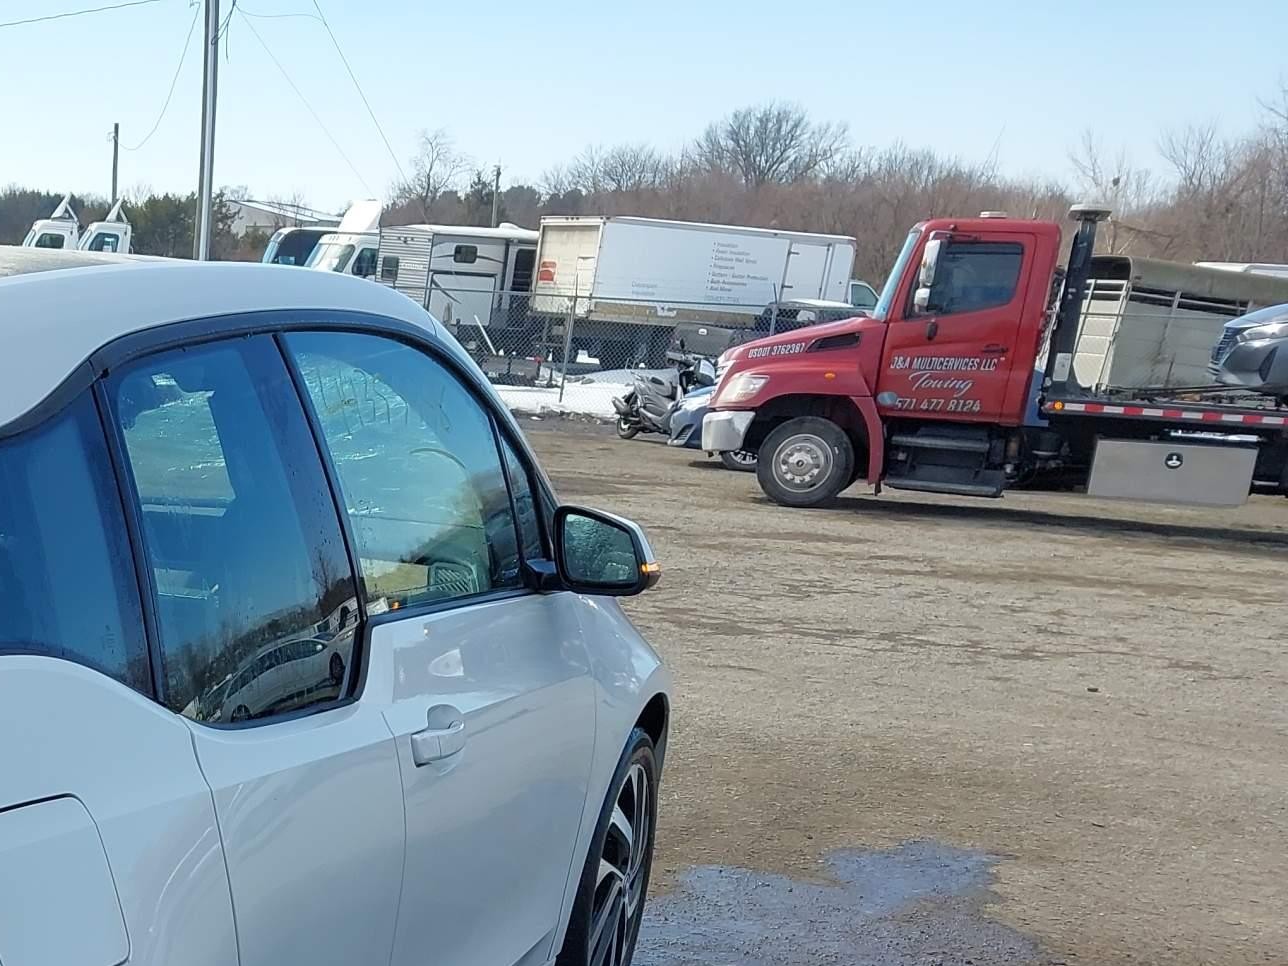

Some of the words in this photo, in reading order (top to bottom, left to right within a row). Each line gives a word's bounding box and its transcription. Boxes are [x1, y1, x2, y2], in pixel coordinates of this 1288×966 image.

[890, 356, 910, 369] J&A
[980, 358, 998, 371] LLC
[908, 370, 974, 397] Towing
[895, 398, 917, 409] 571
[920, 398, 944, 410] 477
[947, 399, 981, 412] 8124
